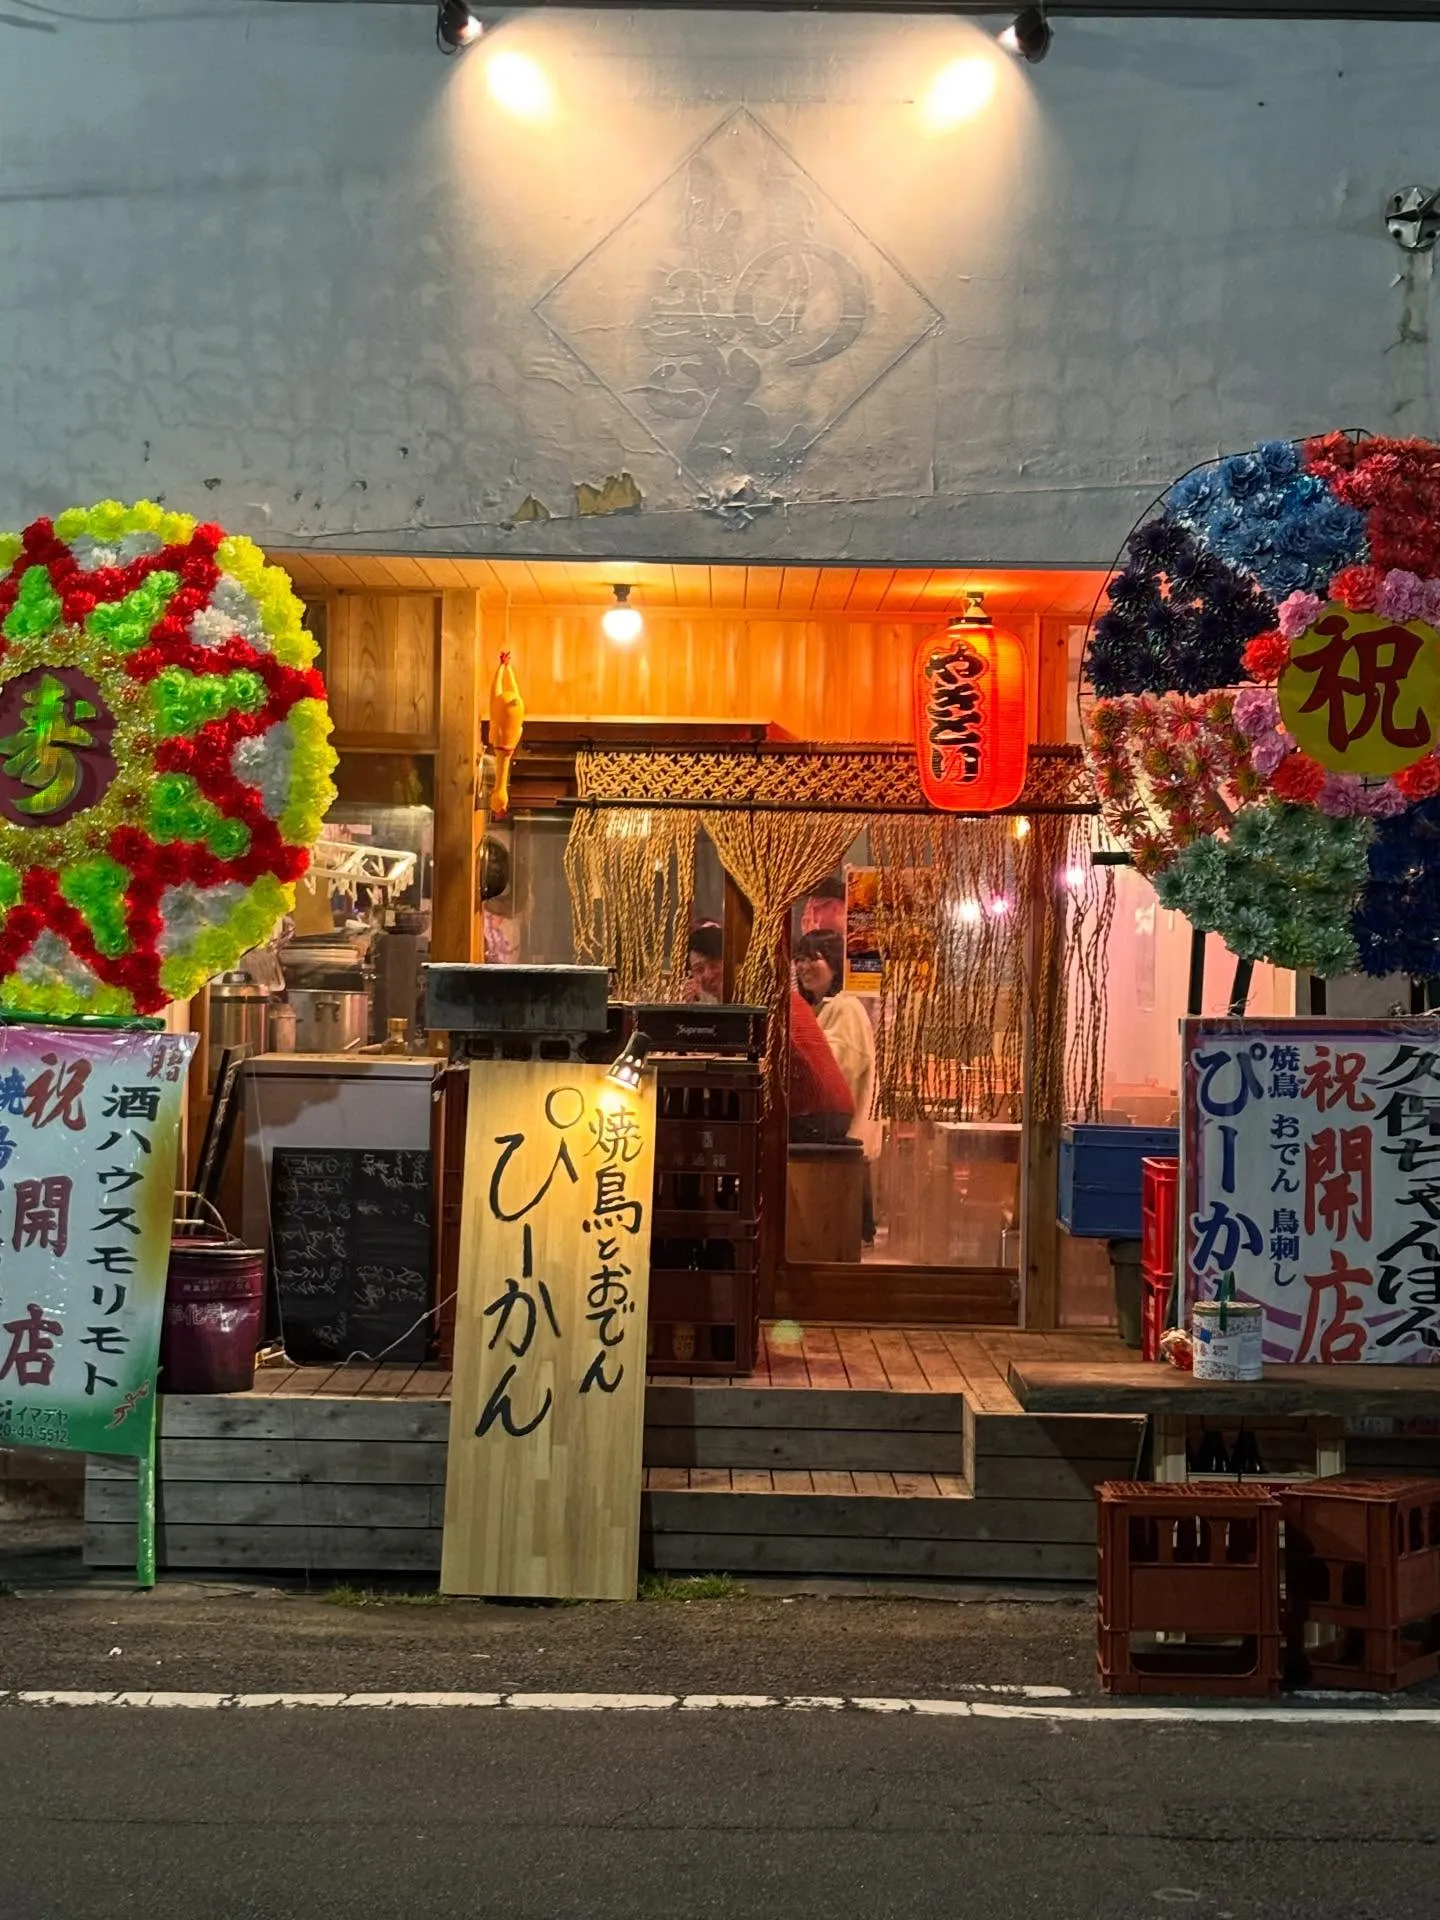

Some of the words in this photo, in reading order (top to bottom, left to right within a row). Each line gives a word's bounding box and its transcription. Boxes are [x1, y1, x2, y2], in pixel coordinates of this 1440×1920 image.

[1292, 615, 1431, 753] 祝
[1194, 1042, 1267, 1300] ぴーか
[1269, 1045, 1300, 1099] 焼鳥
[1270, 1113, 1300, 1193] おでん
[1301, 1045, 1378, 1363] 祝開店
[0, 1053, 93, 1387] 祝開店
[79, 1084, 162, 1396] 酒ハウスモリモト
[475, 1087, 584, 1437] ぴーかん
[579, 1105, 644, 1394] 焼鳥とおでん
[1269, 1208, 1300, 1287] 鳥刺し
